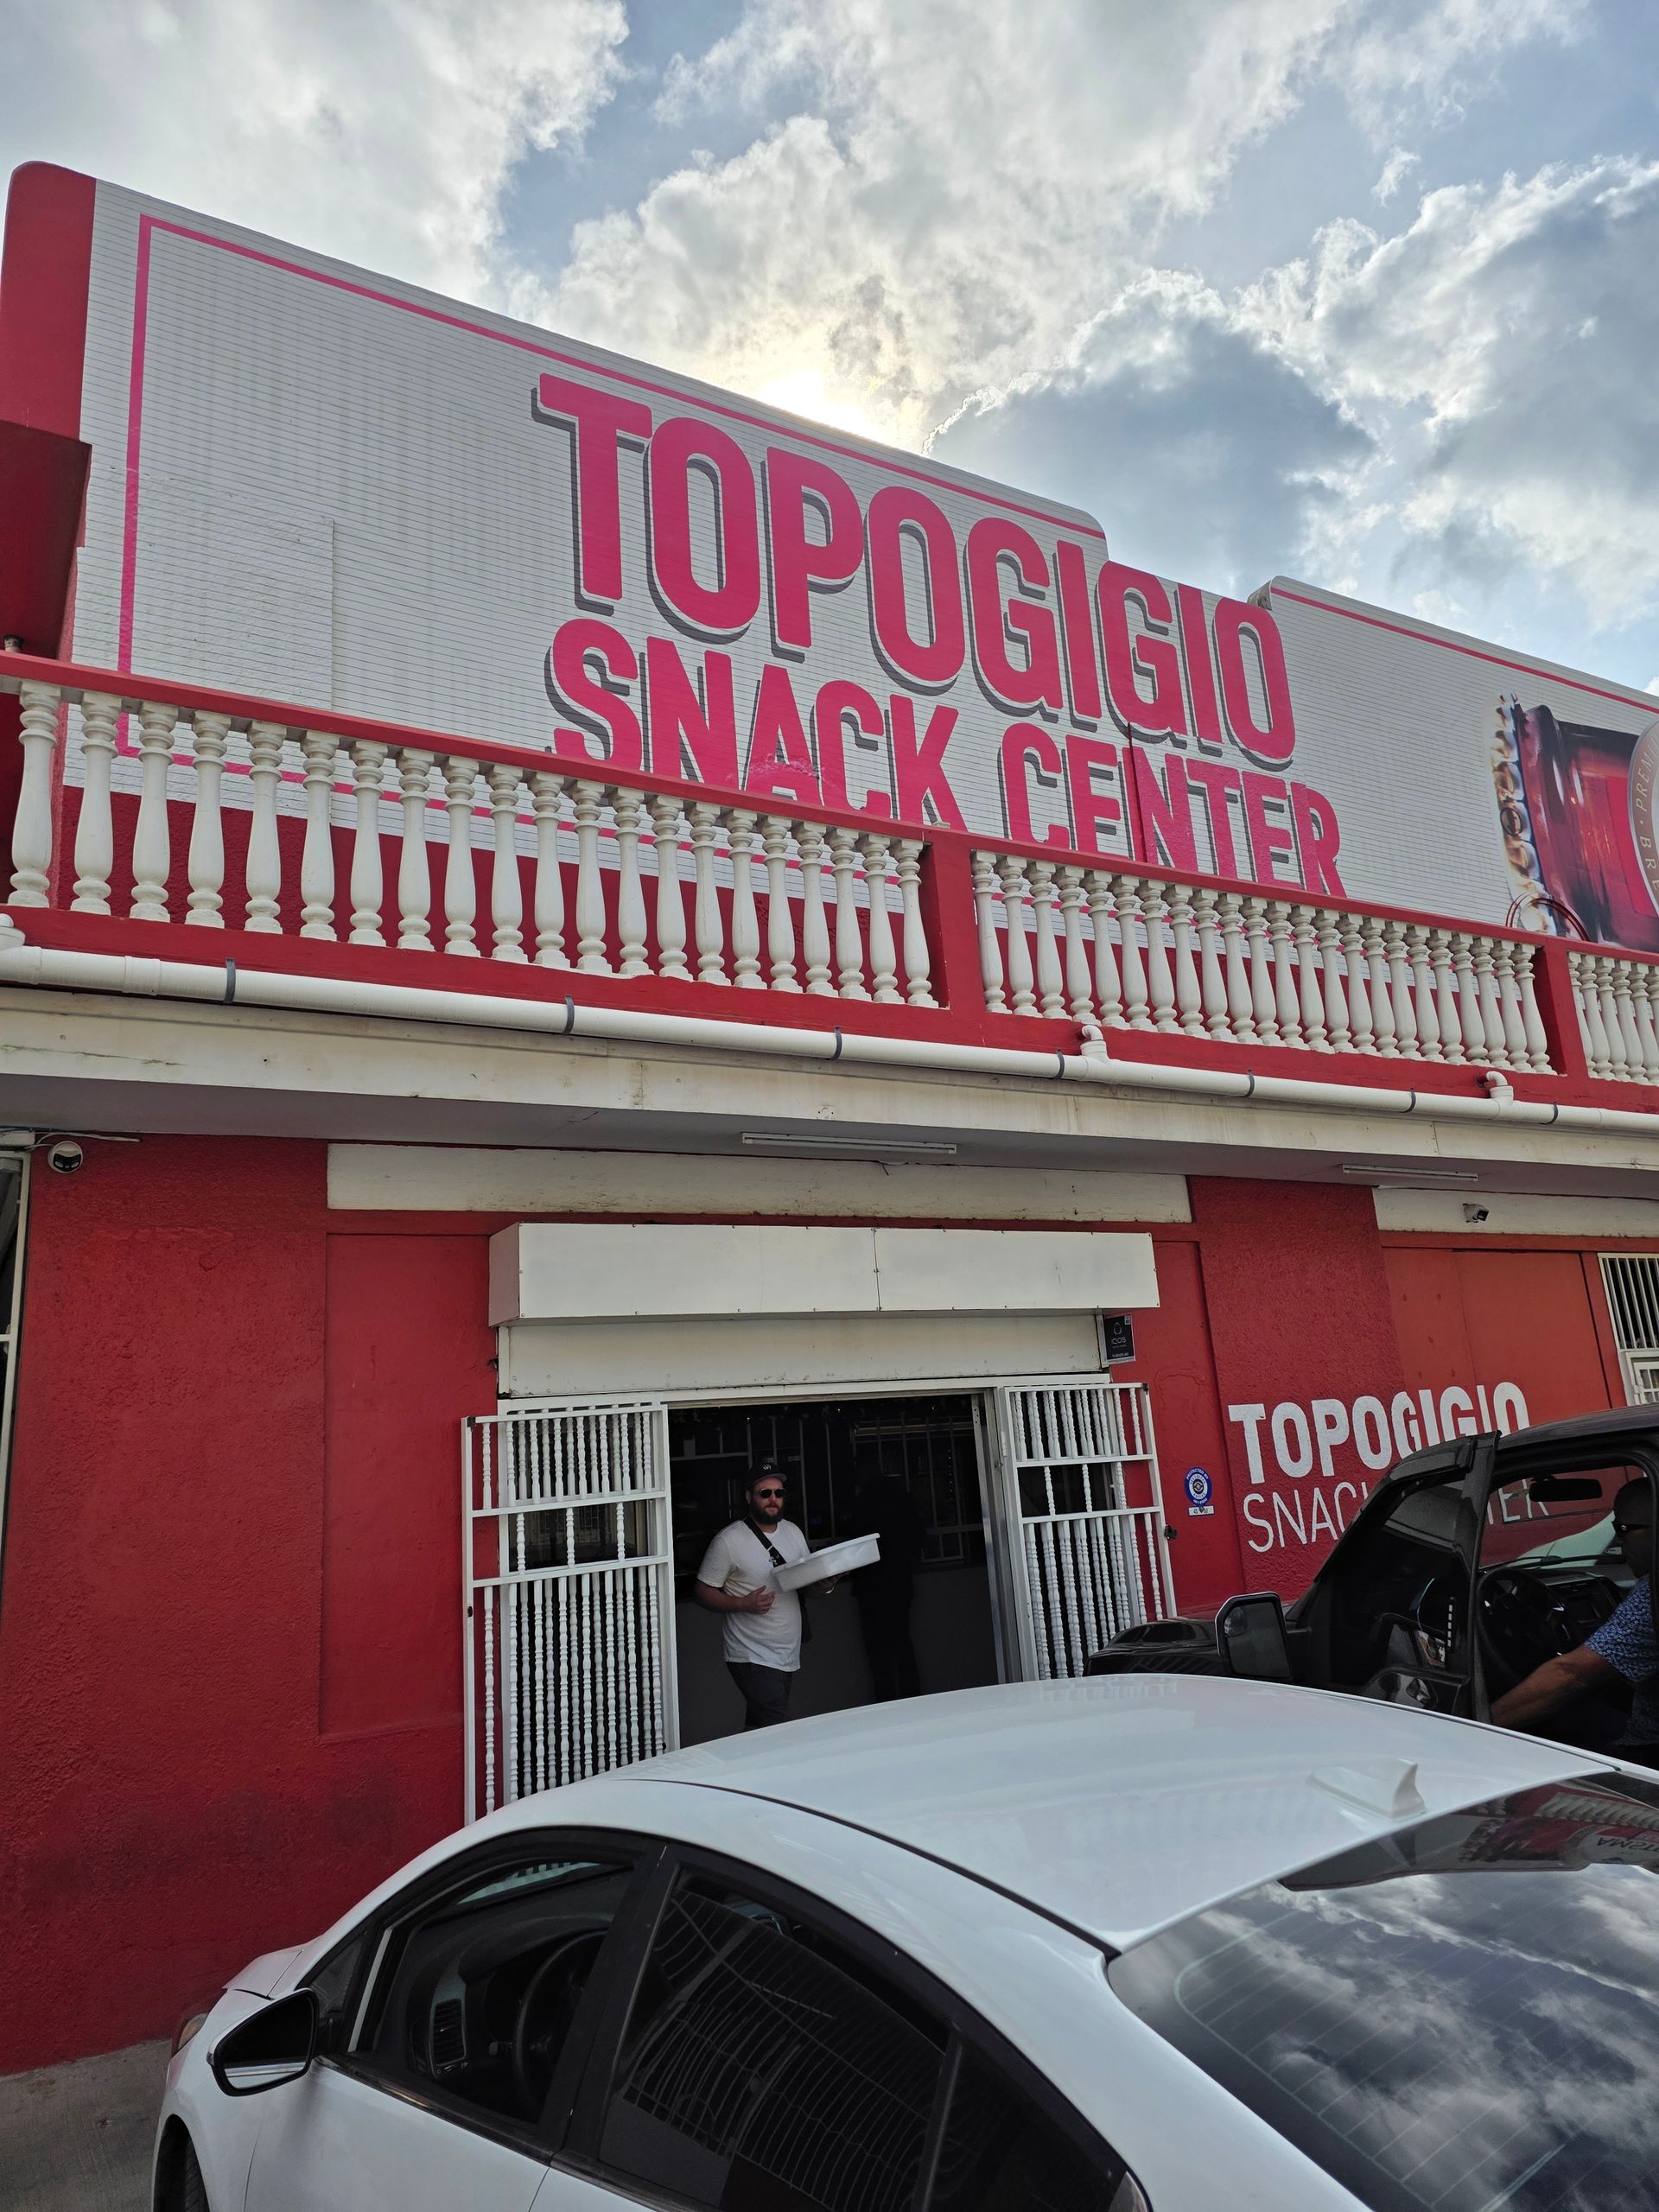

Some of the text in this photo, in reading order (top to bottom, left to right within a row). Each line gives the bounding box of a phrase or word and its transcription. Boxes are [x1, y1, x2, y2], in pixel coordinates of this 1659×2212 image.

[532, 373, 1295, 771] TOPOGIGIO
[544, 619, 1346, 898] SNACK CENTER
[1228, 1382, 1530, 1484] TOPOGIGIO
